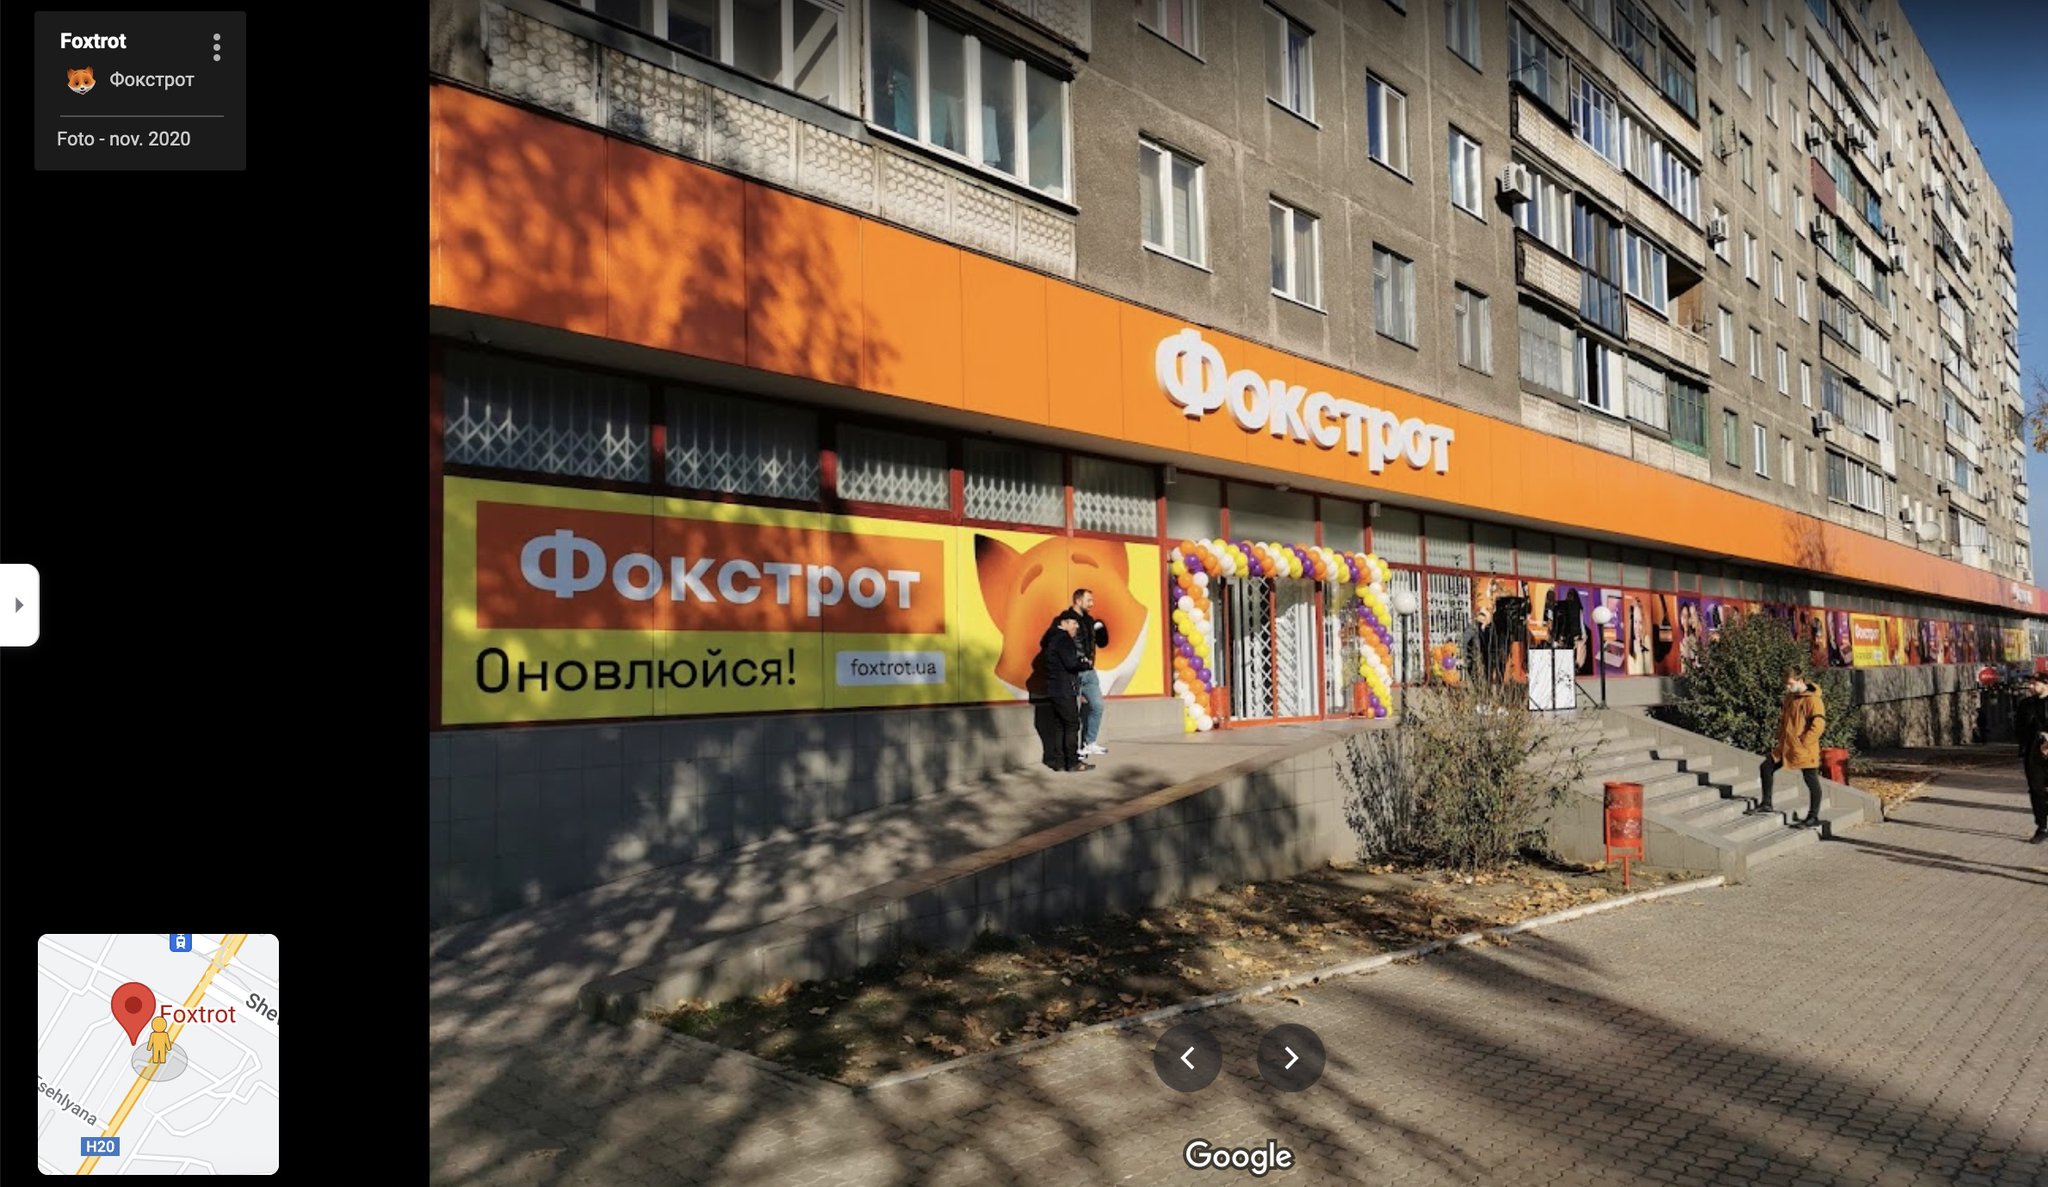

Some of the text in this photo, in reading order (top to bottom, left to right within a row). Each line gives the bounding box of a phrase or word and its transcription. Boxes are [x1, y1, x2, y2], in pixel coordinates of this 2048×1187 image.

[1155, 327, 1455, 475] Фокстрот
[519, 528, 921, 617] Фокстрот
[476, 647, 797, 693] Оновлюйся!
[849, 657, 937, 678] foxtrot.ua
